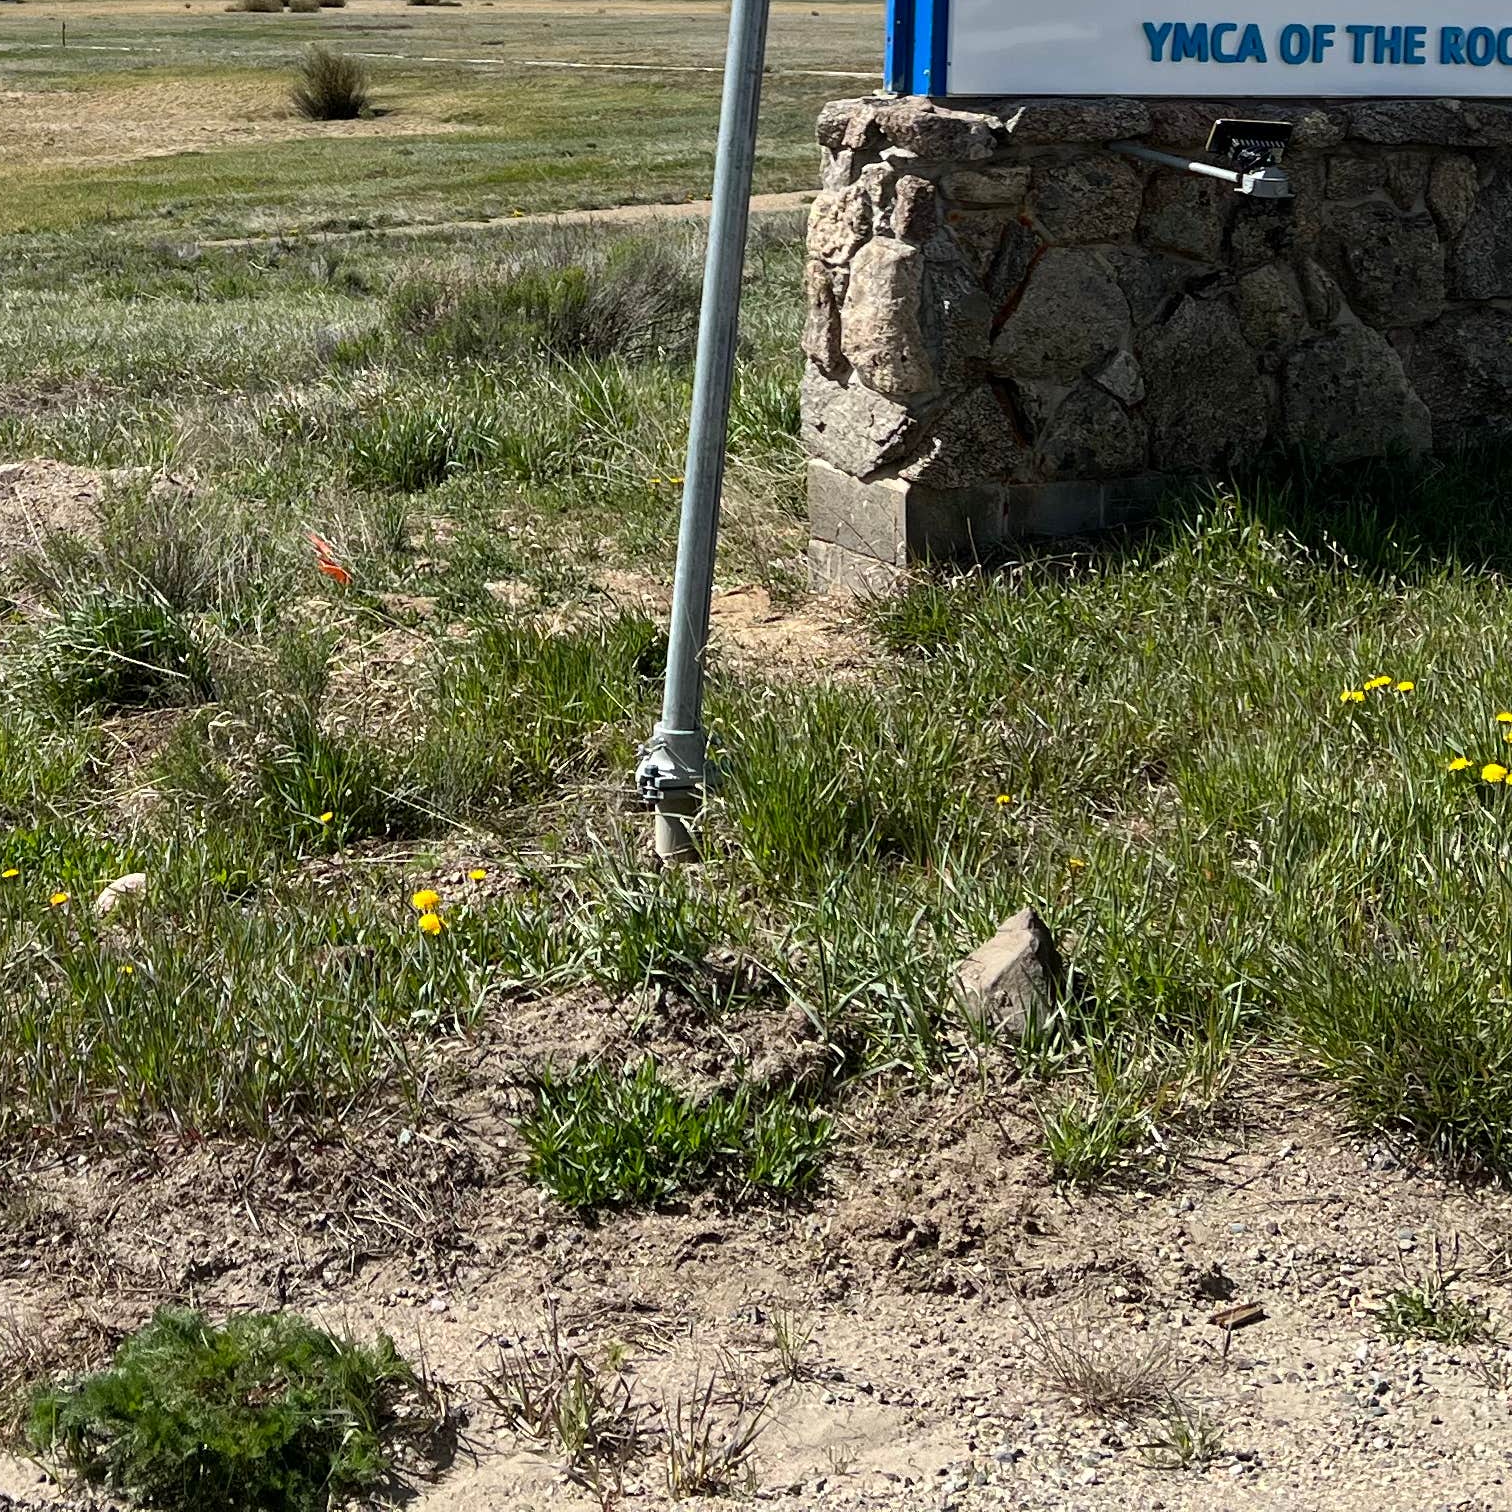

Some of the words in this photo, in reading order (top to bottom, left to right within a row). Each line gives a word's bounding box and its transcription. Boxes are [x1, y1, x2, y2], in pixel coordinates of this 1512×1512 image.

[1143, 21, 1266, 64] YMCA
[1279, 23, 1336, 66] OF
[1346, 24, 1427, 65] THE
